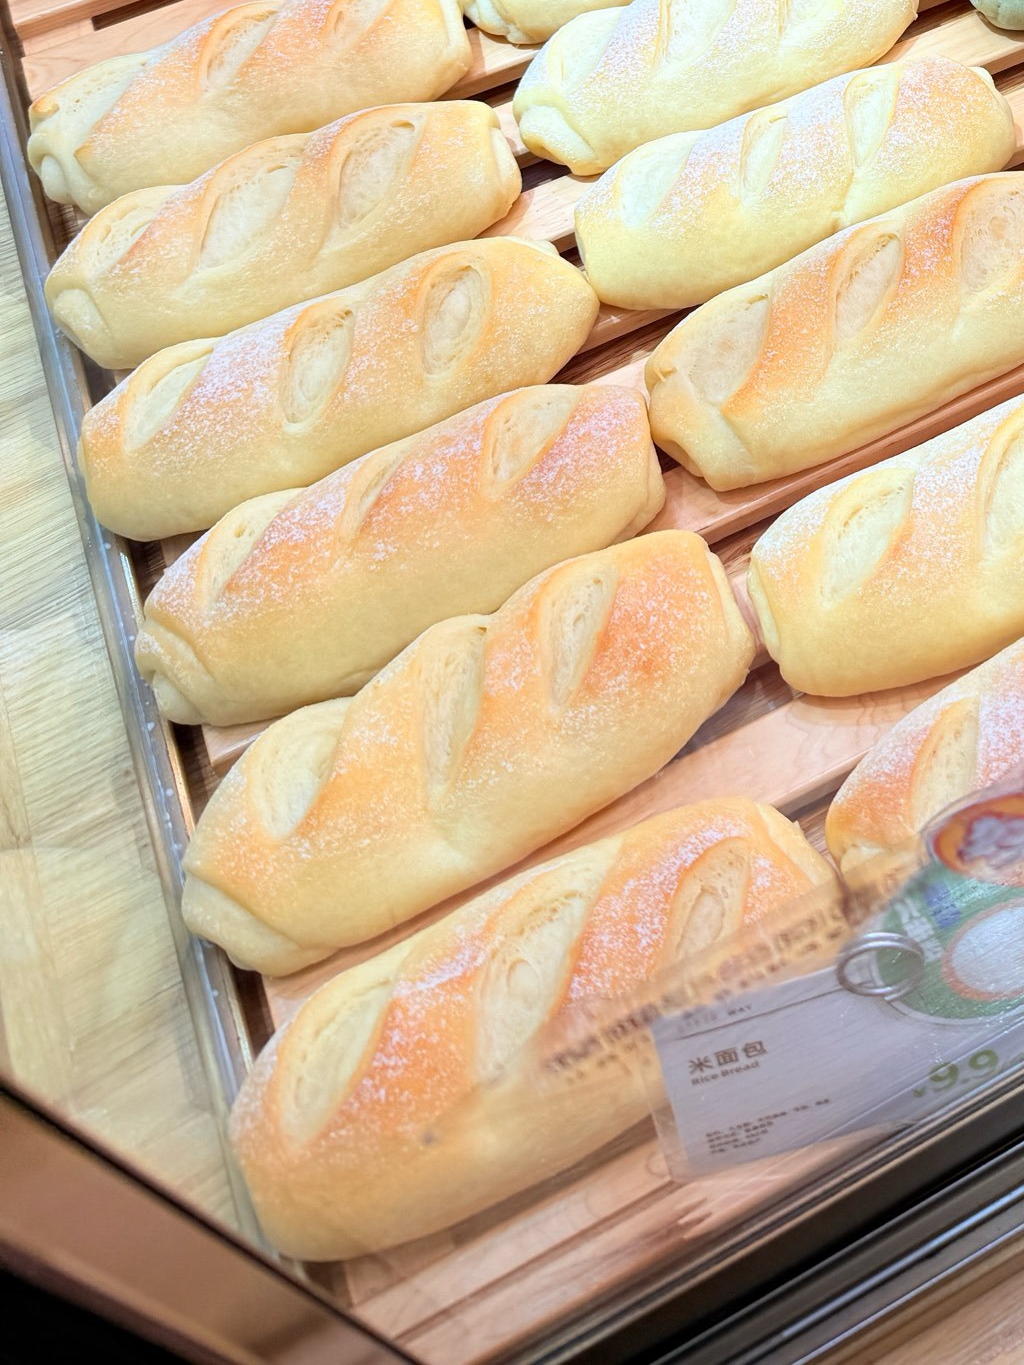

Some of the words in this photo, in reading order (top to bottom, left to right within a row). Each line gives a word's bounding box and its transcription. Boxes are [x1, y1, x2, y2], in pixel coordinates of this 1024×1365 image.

[688, 1040, 768, 1075] 米面包
[691, 1072, 719, 1086] Rice
[720, 1060, 760, 1077] Bread
